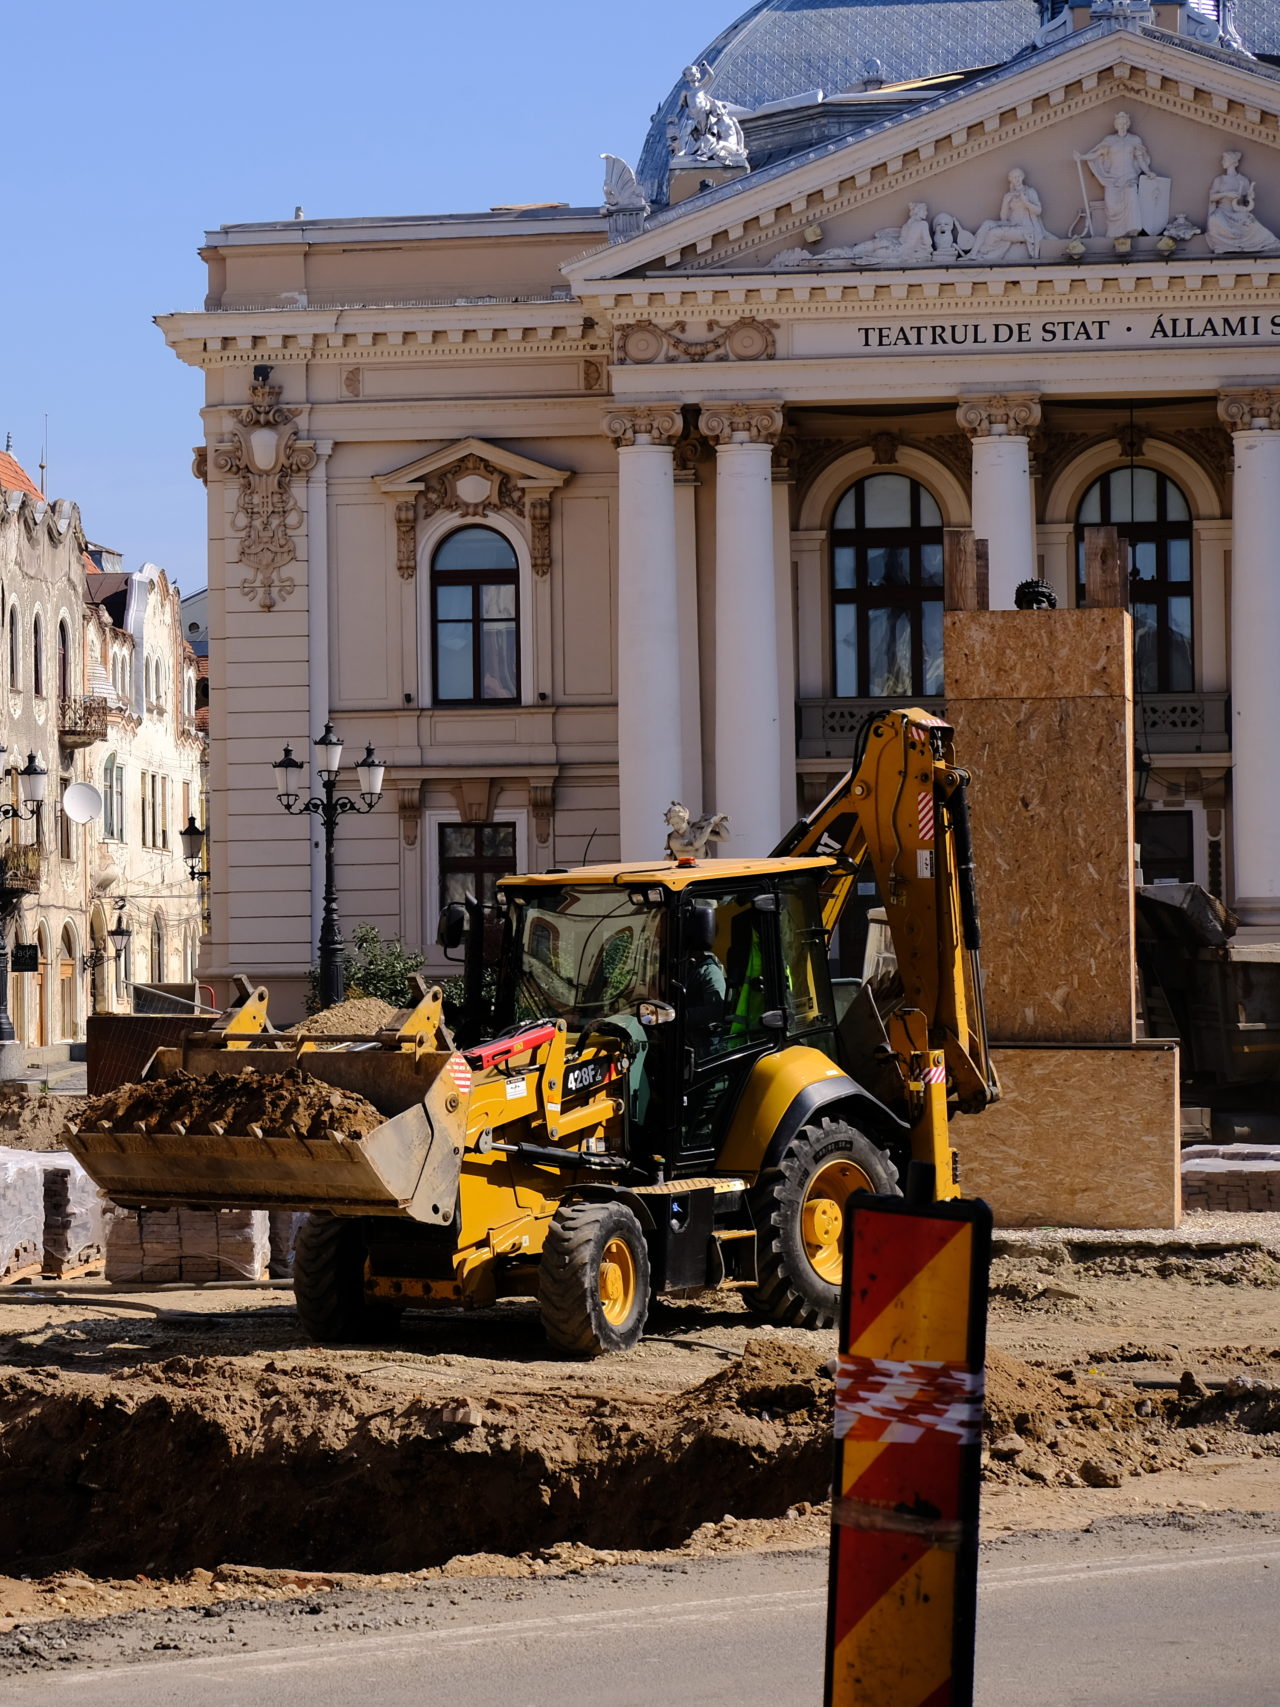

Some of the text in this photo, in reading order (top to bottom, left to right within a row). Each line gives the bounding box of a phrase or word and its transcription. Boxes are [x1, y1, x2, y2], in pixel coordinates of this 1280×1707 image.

[858, 324, 987, 347] TEATRUL
[993, 322, 1032, 343] DE
[1041, 320, 1110, 342] STAT
[1150, 314, 1261, 339] ÁLLAMI
[816, 832, 842, 854] AT
